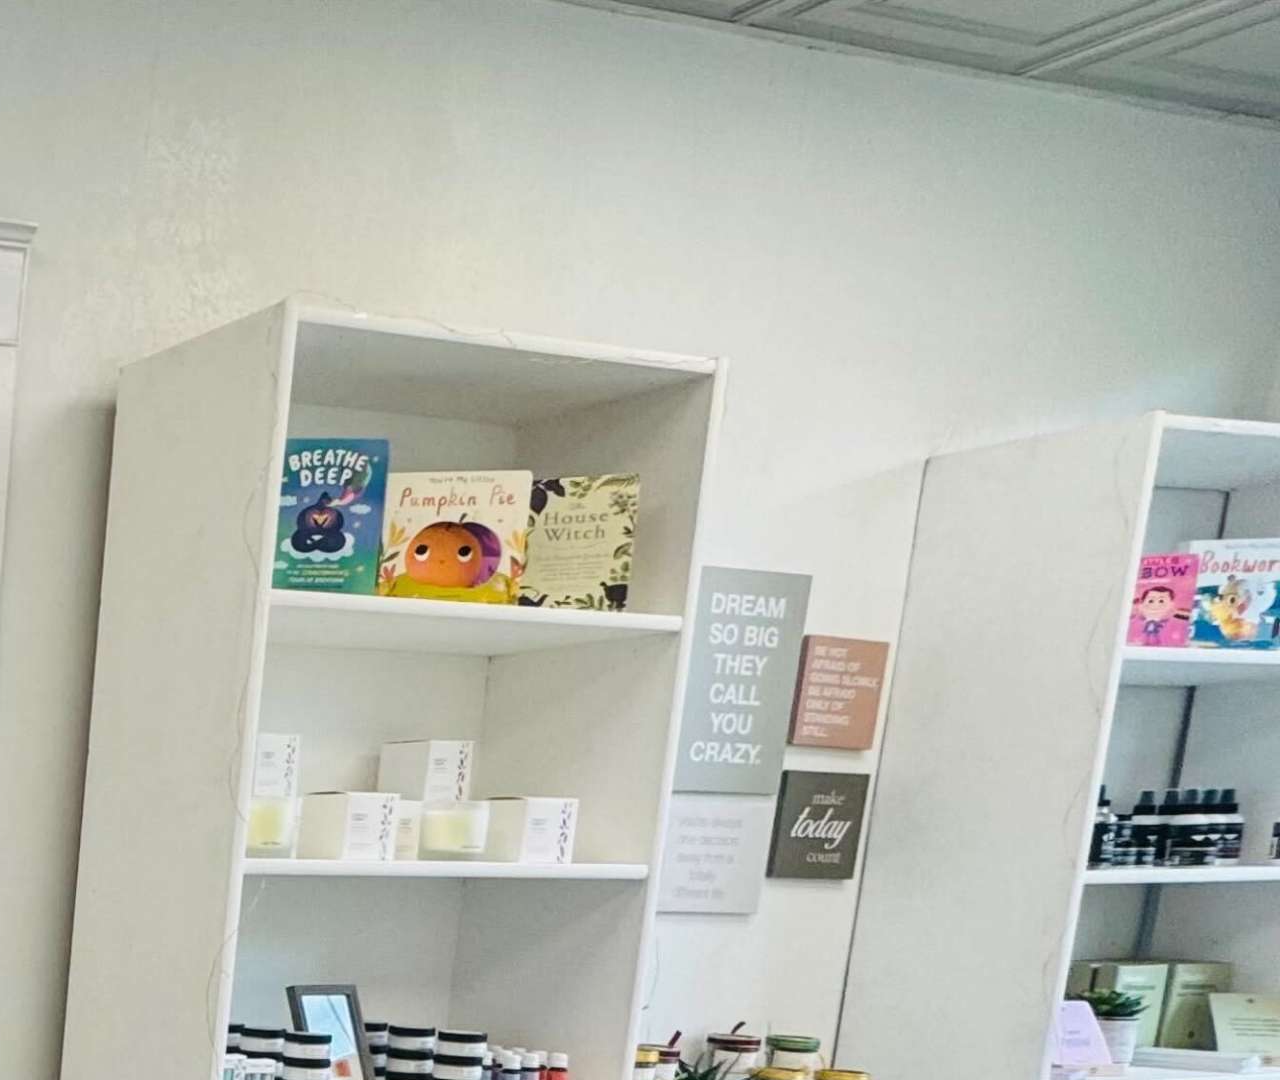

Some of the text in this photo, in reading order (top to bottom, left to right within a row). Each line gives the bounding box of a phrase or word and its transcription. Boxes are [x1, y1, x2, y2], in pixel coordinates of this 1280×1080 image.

[288, 449, 369, 472] BREATHE
[300, 467, 353, 487] DEEP
[399, 484, 516, 516] Pumpkin Pie
[543, 512, 609, 526] House
[544, 525, 606, 542] Witch
[711, 592, 786, 619] DREAM
[708, 622, 779, 648] SO BIG
[713, 652, 768, 677] THEY
[709, 682, 761, 706] CALL
[711, 712, 752, 735] YOU
[689, 740, 762, 765] CRAZY.
[790, 806, 852, 849] today
